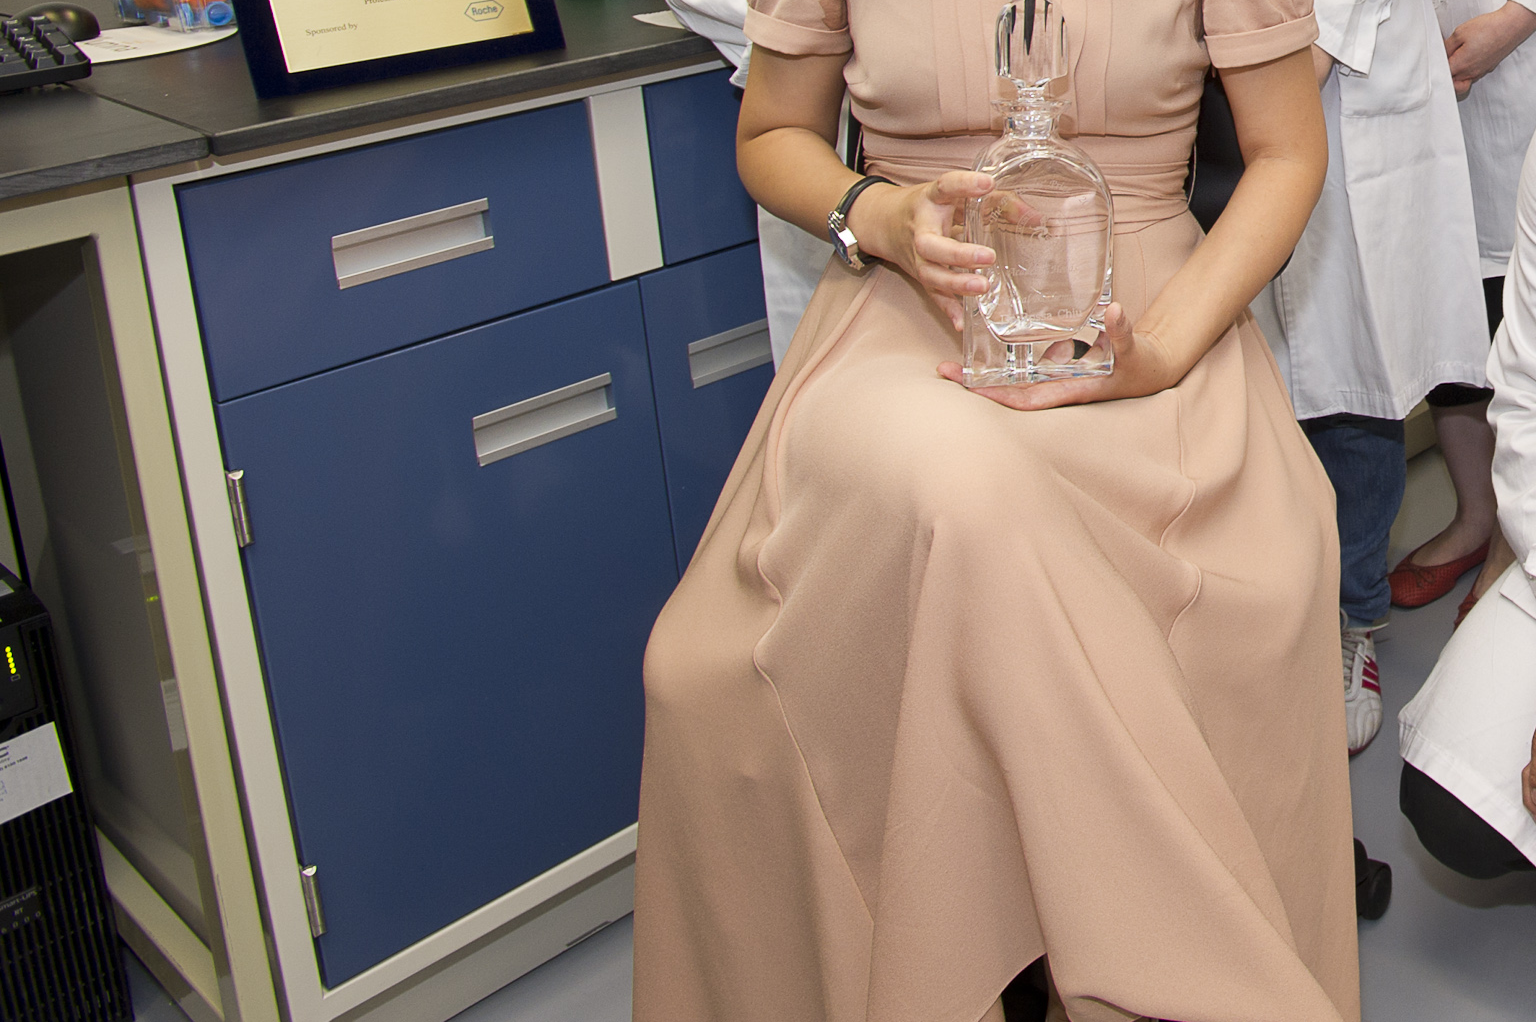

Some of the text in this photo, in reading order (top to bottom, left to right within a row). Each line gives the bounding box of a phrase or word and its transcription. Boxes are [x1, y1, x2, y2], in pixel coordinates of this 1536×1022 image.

[471, 5, 498, 16] Roche
[305, 22, 358, 37] Sponsored by
